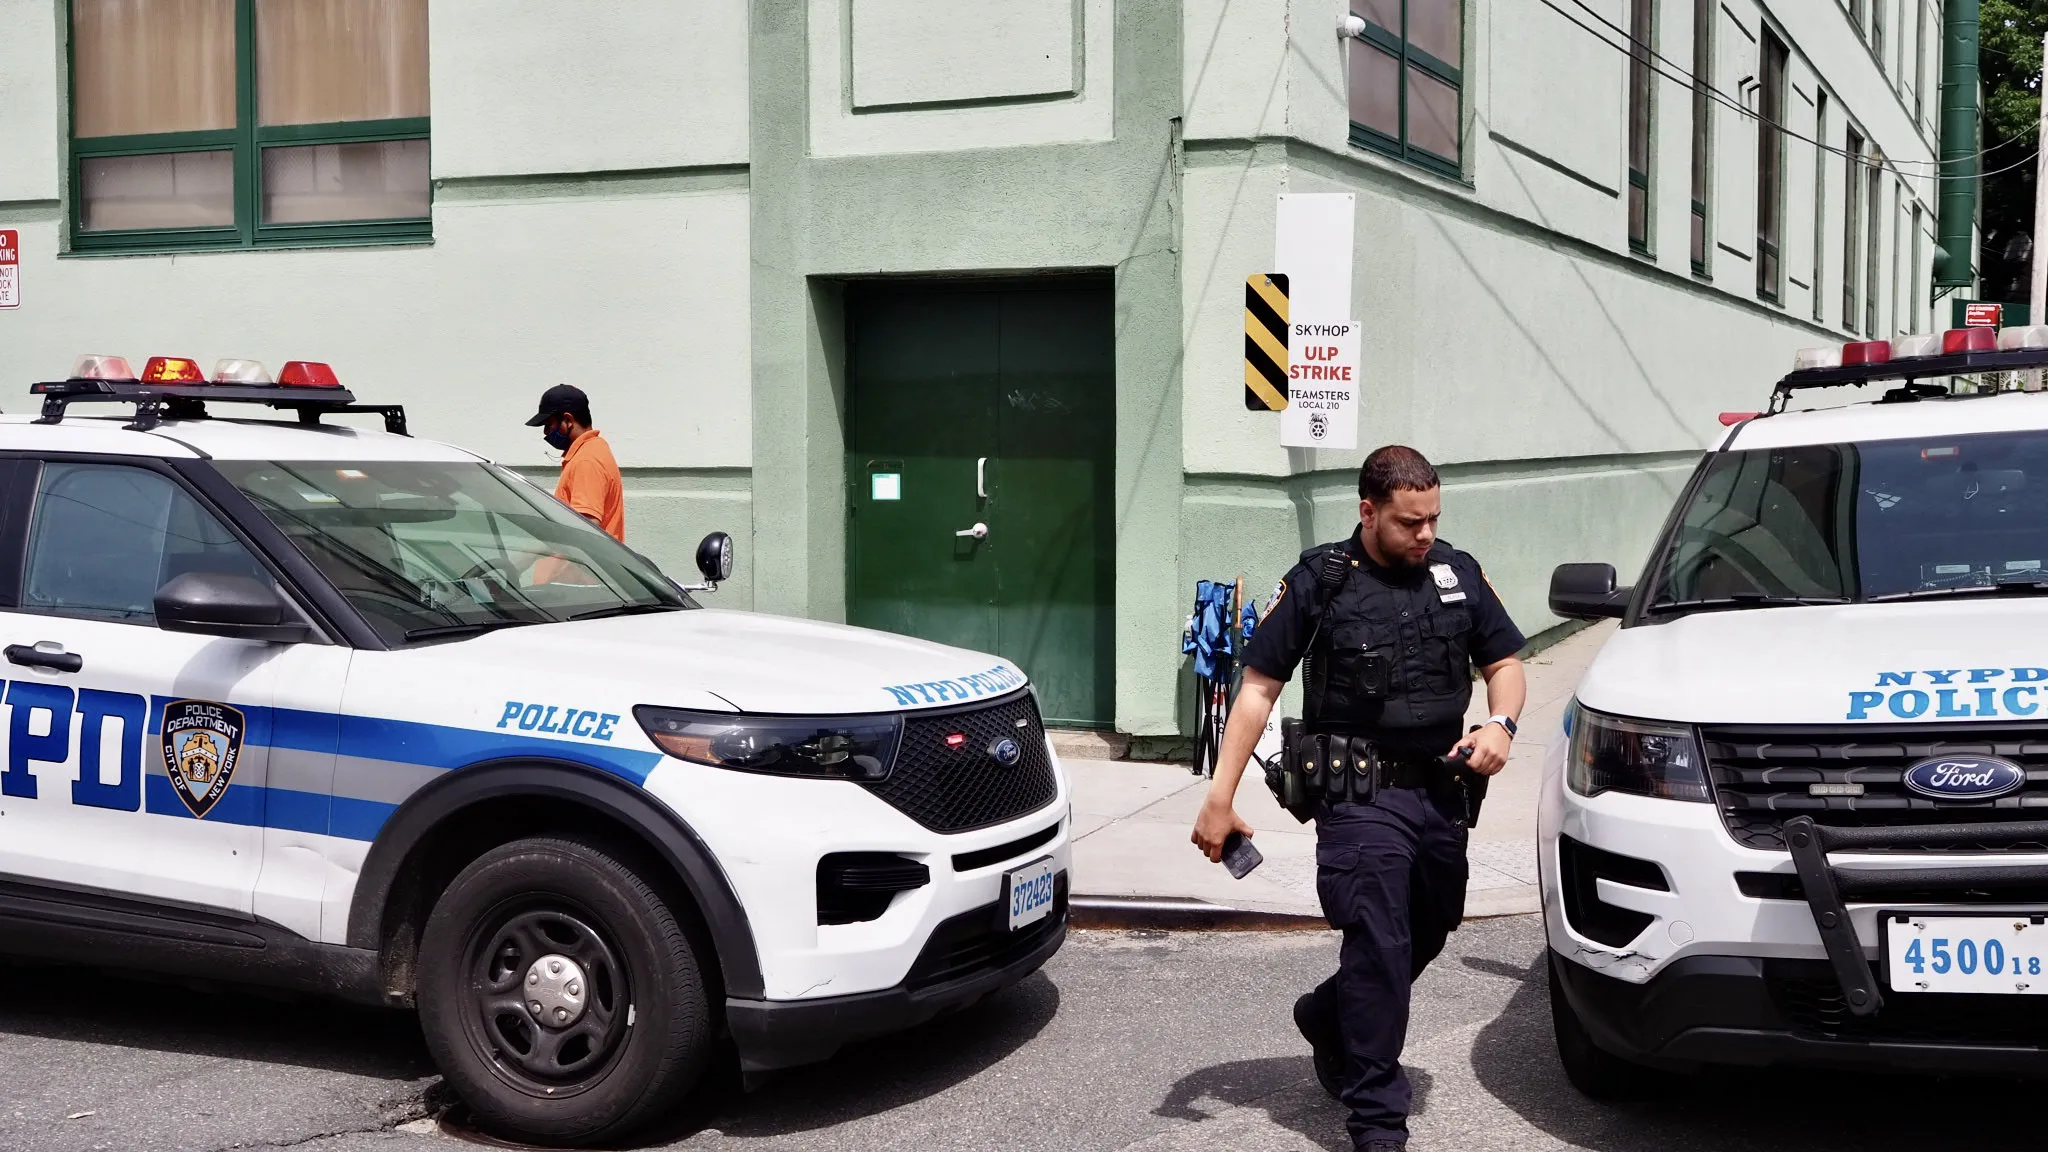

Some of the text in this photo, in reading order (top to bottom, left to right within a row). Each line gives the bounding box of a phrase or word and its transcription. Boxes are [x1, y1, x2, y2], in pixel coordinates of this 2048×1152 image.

[1295, 324, 1349, 336] SKYHOP
[1305, 346, 1339, 361] ULP
[1289, 364, 1352, 381] STRIKE
[1289, 389, 1350, 401] TEAMSTERS
[1298, 401, 1340, 410] LOCAL 210
[880, 665, 1022, 706] NYPD POLICE
[1875, 667, 2048, 687] NYPD
[185, 704, 223, 719] POLICE
[1846, 686, 2048, 720] POLIC
[167, 716, 239, 739] DEPARTMENT
[496, 701, 621, 741] POLICE
[0, 678, 148, 812] PD
[165, 745, 187, 791] CITY OF
[209, 747, 237, 800] NEW YORK
[1930, 762, 1995, 788] Ford
[1013, 872, 1052, 917] 372423
[1904, 938, 2041, 976] 4500 18
